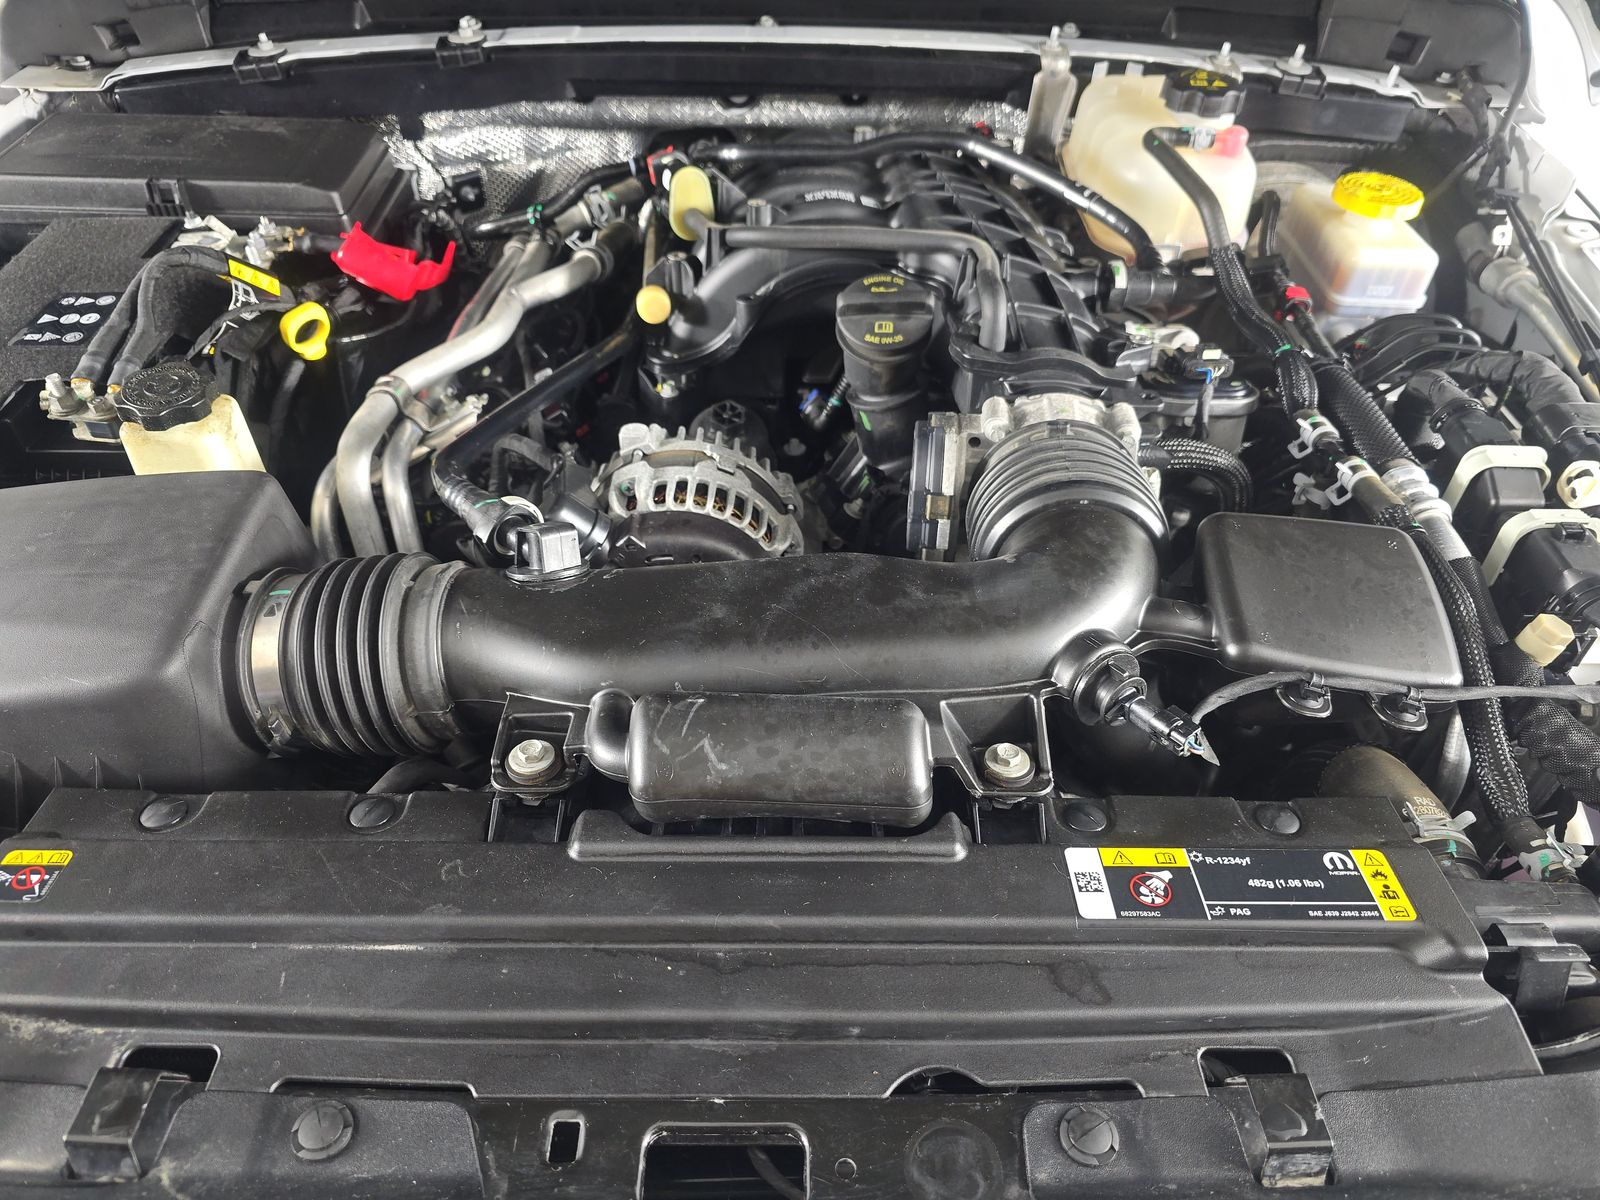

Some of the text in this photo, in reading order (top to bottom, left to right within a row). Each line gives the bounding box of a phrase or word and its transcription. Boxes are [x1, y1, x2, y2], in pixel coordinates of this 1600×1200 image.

[863, 275, 905, 286] ENGINE OIL
[864, 333, 880, 344] SAE
[1413, 796, 1436, 806] RAD
[1204, 856, 1251, 866] R-1234yf
[1247, 879, 1275, 889] 482g
[1302, 879, 1325, 890] lbs)
[1229, 907, 1251, 916] PAG
